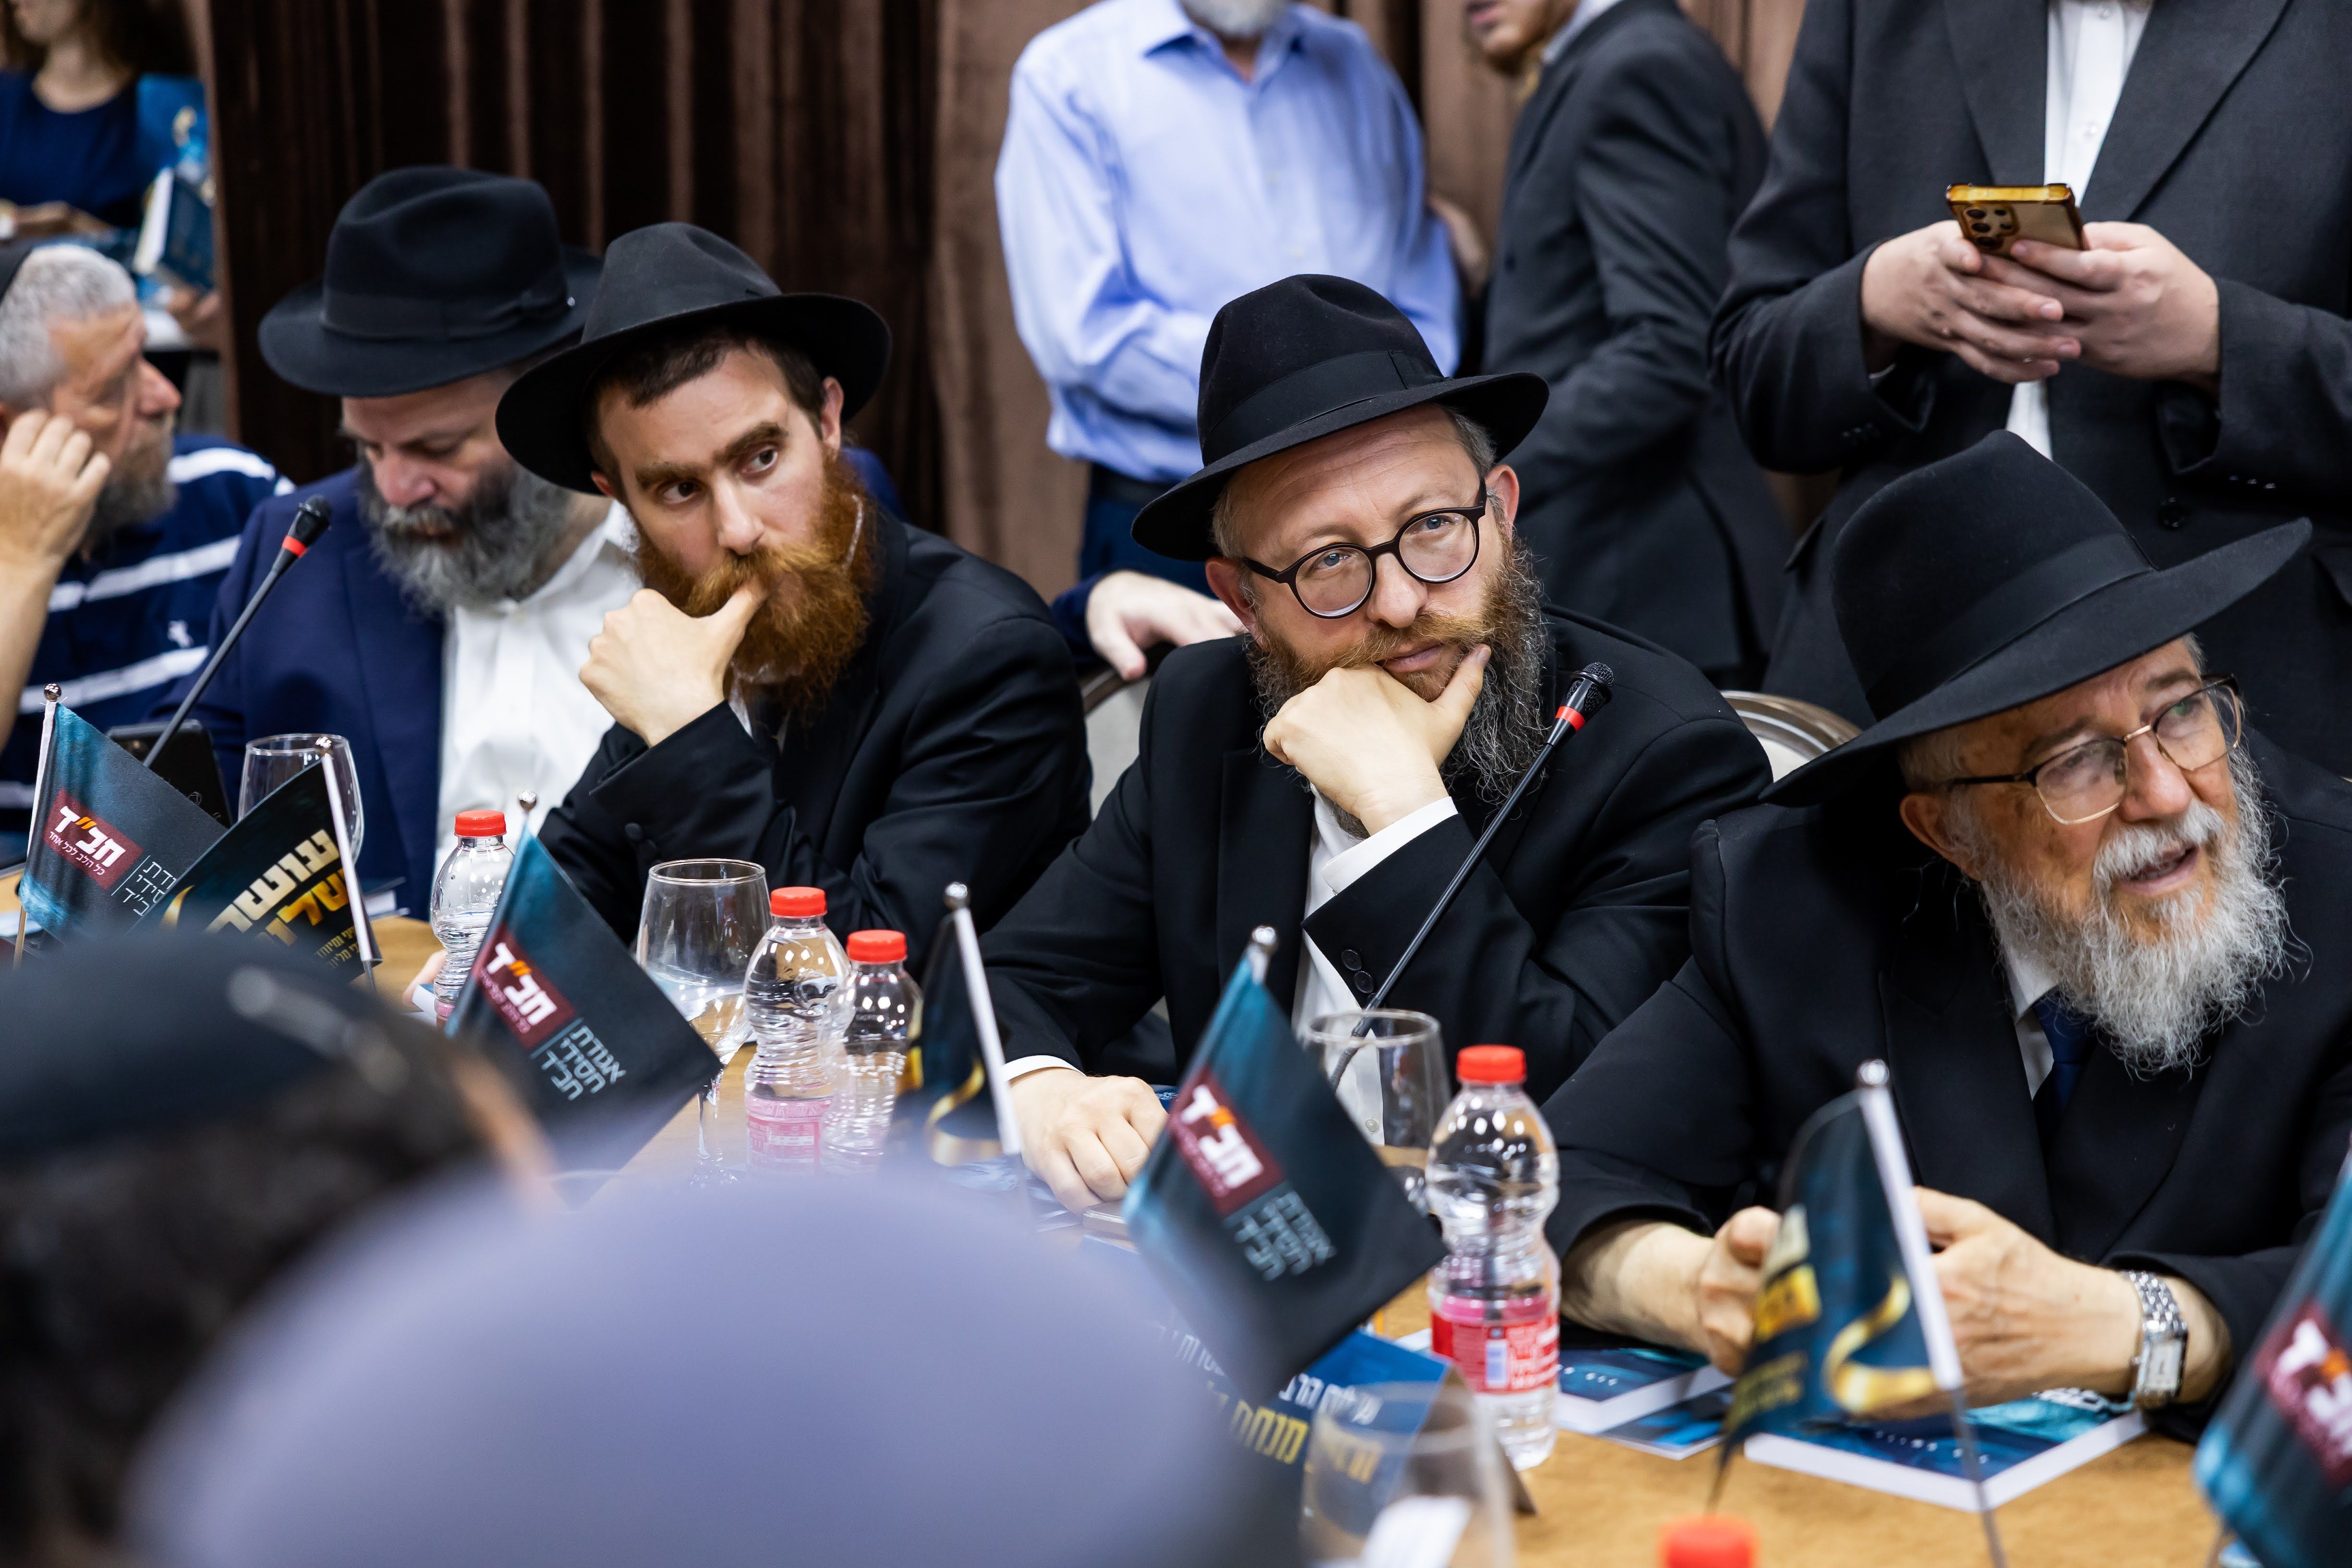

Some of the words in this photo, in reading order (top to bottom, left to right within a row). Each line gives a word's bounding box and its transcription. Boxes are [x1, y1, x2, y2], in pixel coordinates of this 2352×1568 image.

[49, 831, 63, 846] אחד
[55, 806, 126, 867] חב"ד
[62, 841, 77, 855] לכל
[76, 853, 95, 868] הלב
[93, 863, 105, 875] כל
[123, 888, 150, 916] ב"ד
[485, 942, 558, 1025] חב"ד
[561, 1039, 606, 1094] חסידי
